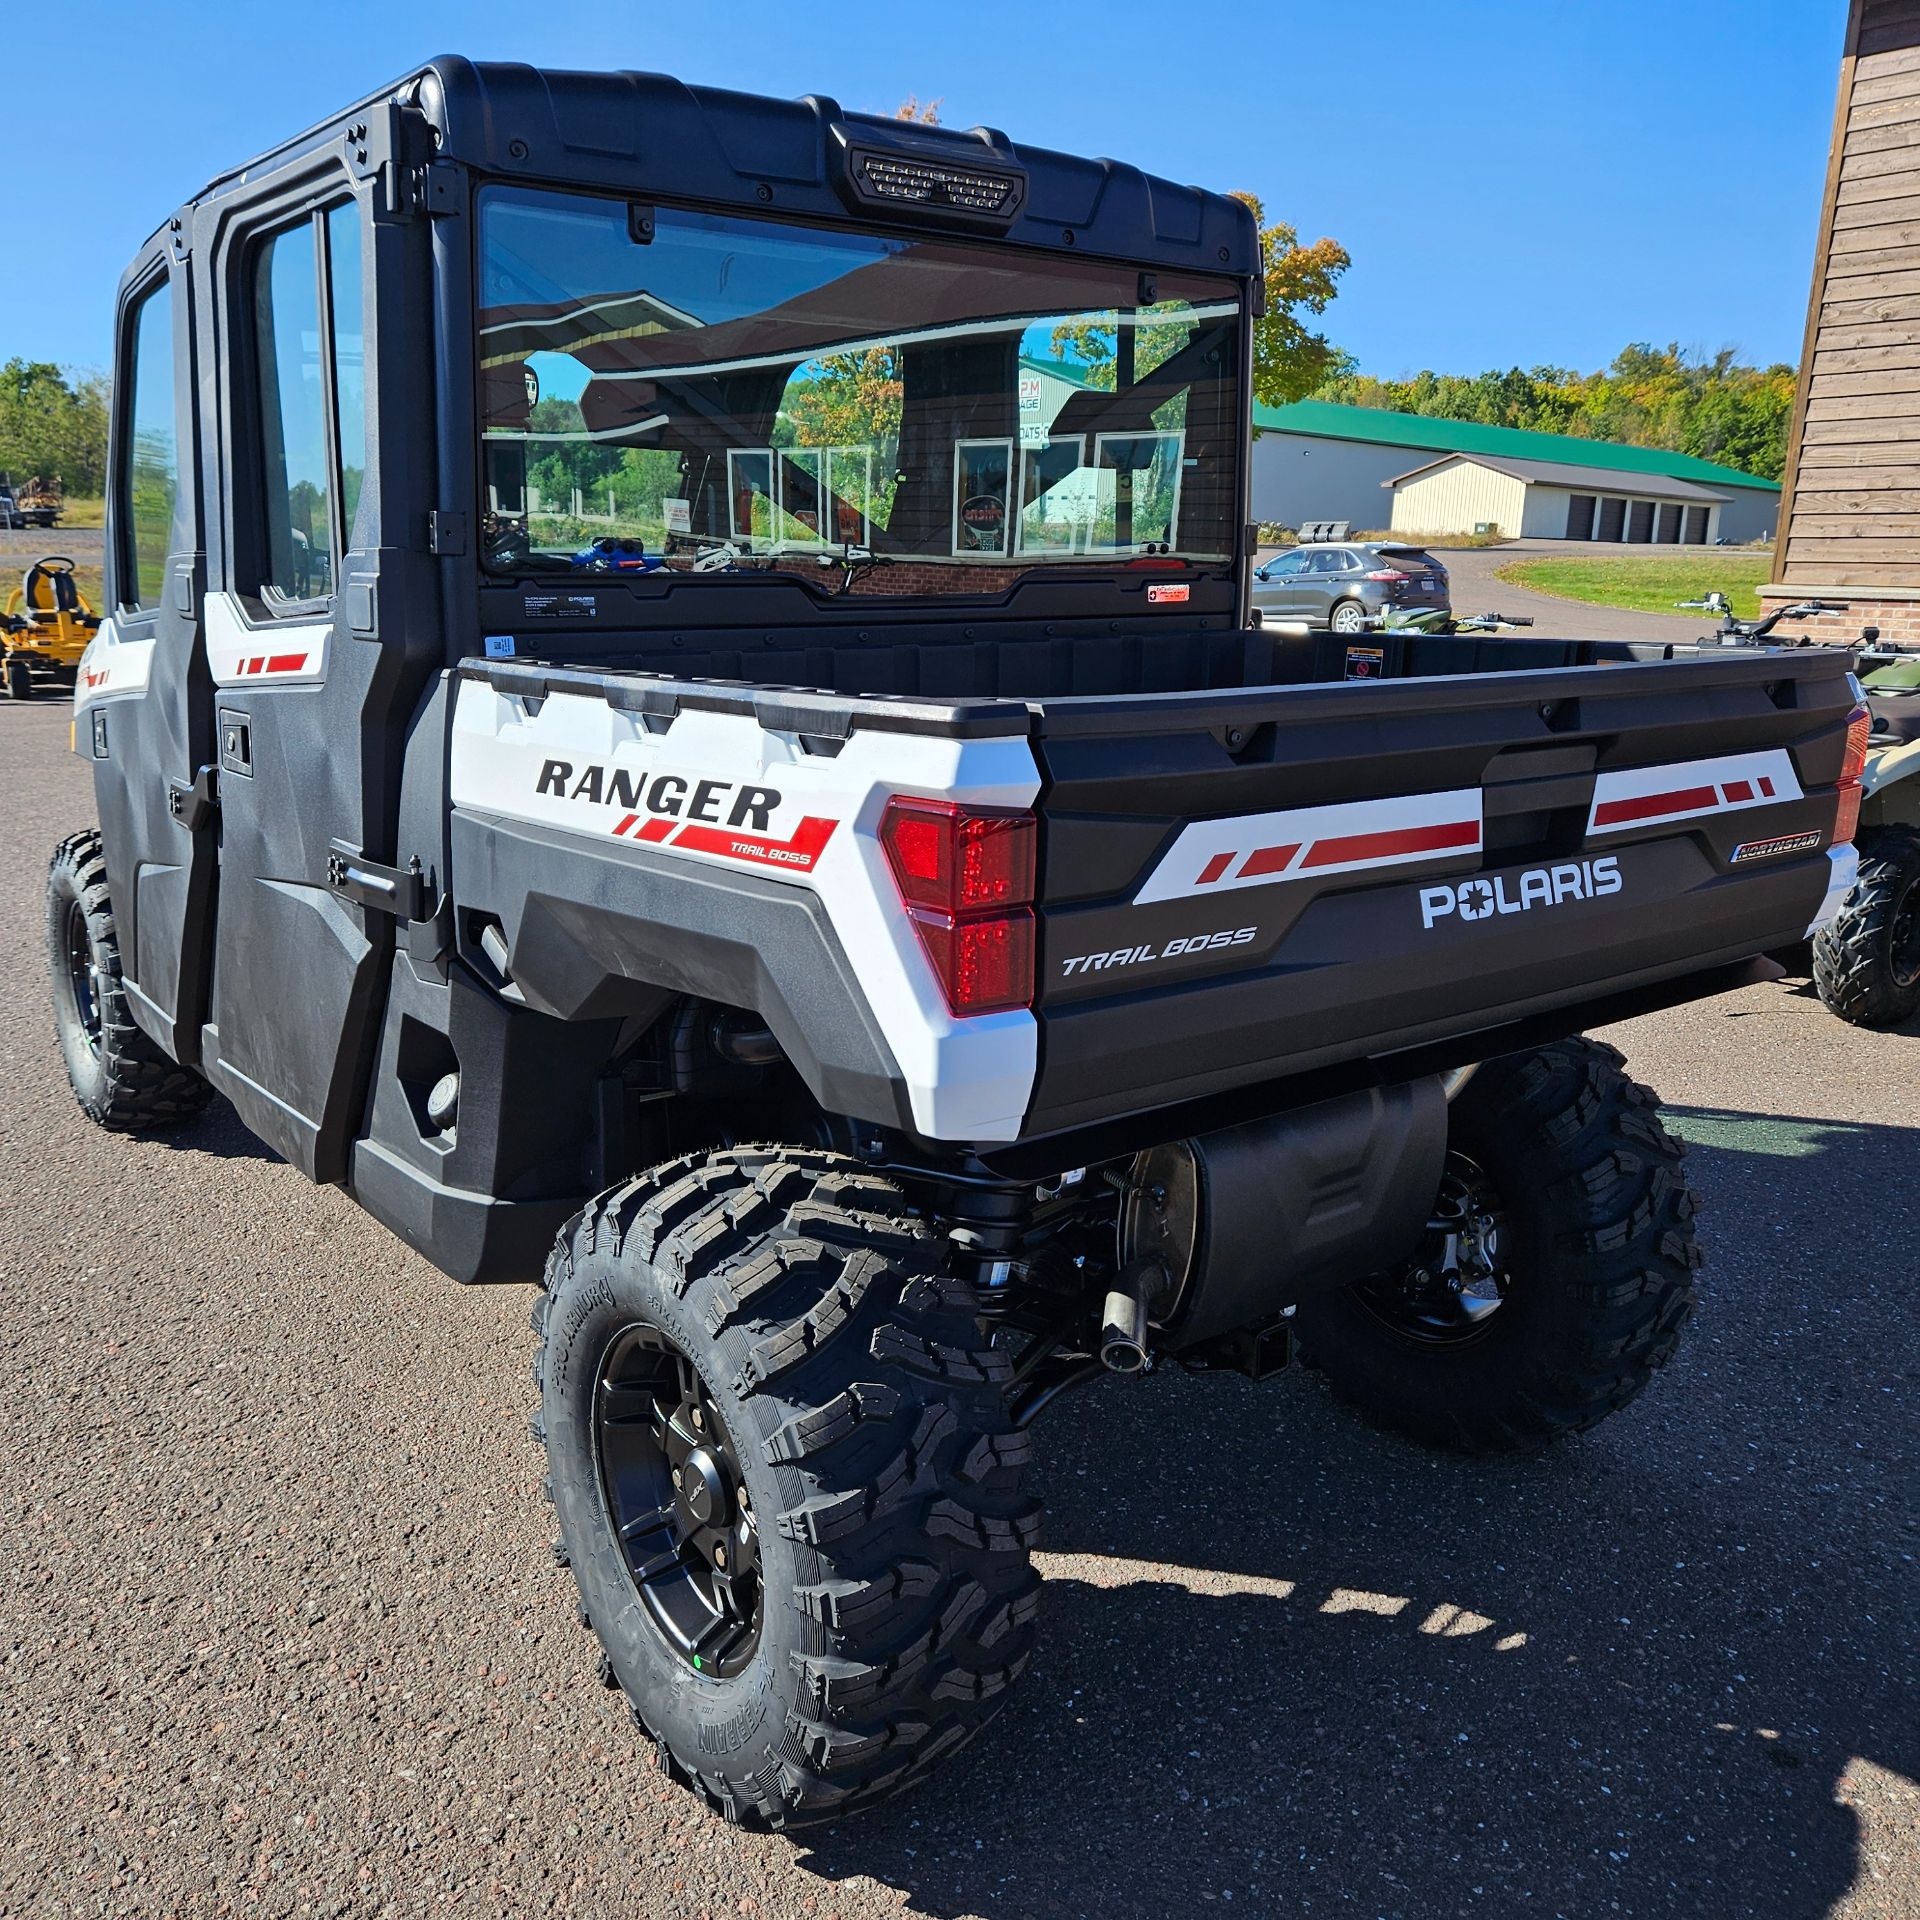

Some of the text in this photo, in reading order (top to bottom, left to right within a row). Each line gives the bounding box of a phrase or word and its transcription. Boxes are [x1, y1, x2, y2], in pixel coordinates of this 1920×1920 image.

[535, 758, 782, 832] RANGER
[731, 841, 811, 865] TRAIL BOSS
[1736, 834, 1818, 859] NORTHSTAR
[1419, 856, 1623, 929] POLARIS
[1063, 926, 1258, 976] TRAIL BOSS
